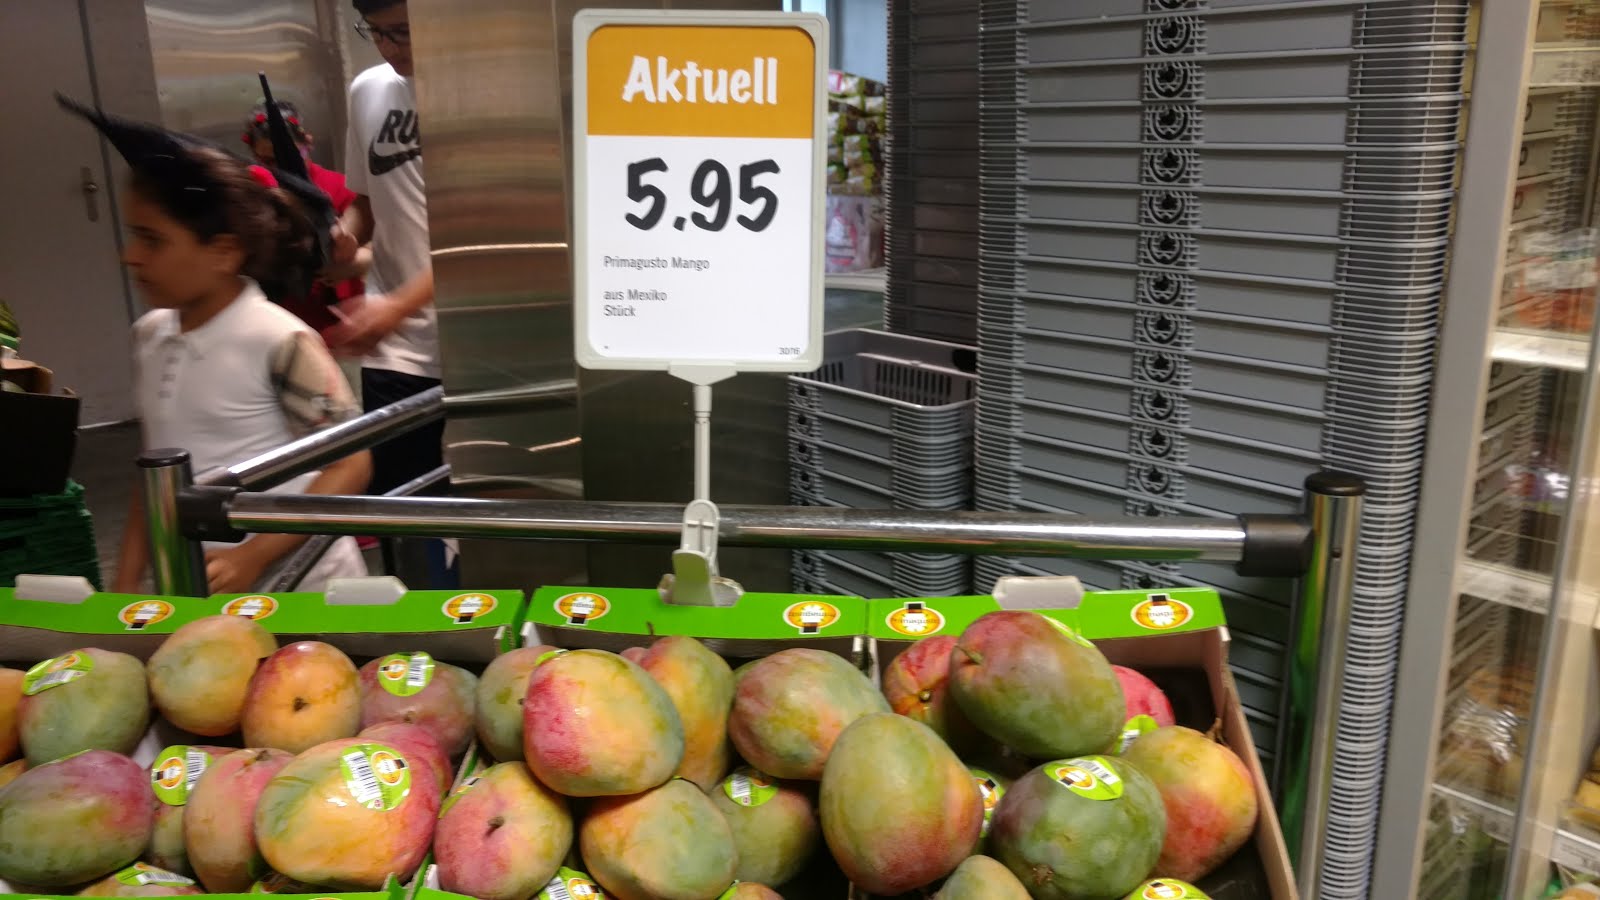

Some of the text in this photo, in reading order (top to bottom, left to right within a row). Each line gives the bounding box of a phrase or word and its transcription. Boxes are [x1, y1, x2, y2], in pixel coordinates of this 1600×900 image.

[622, 55, 779, 105] Aktuell
[376, 109, 421, 144] RU
[625, 158, 781, 232] 5.95
[603, 256, 710, 271] Primagusto Mango
[603, 289, 667, 301] aus Mexiko
[603, 303, 636, 317] Stück
